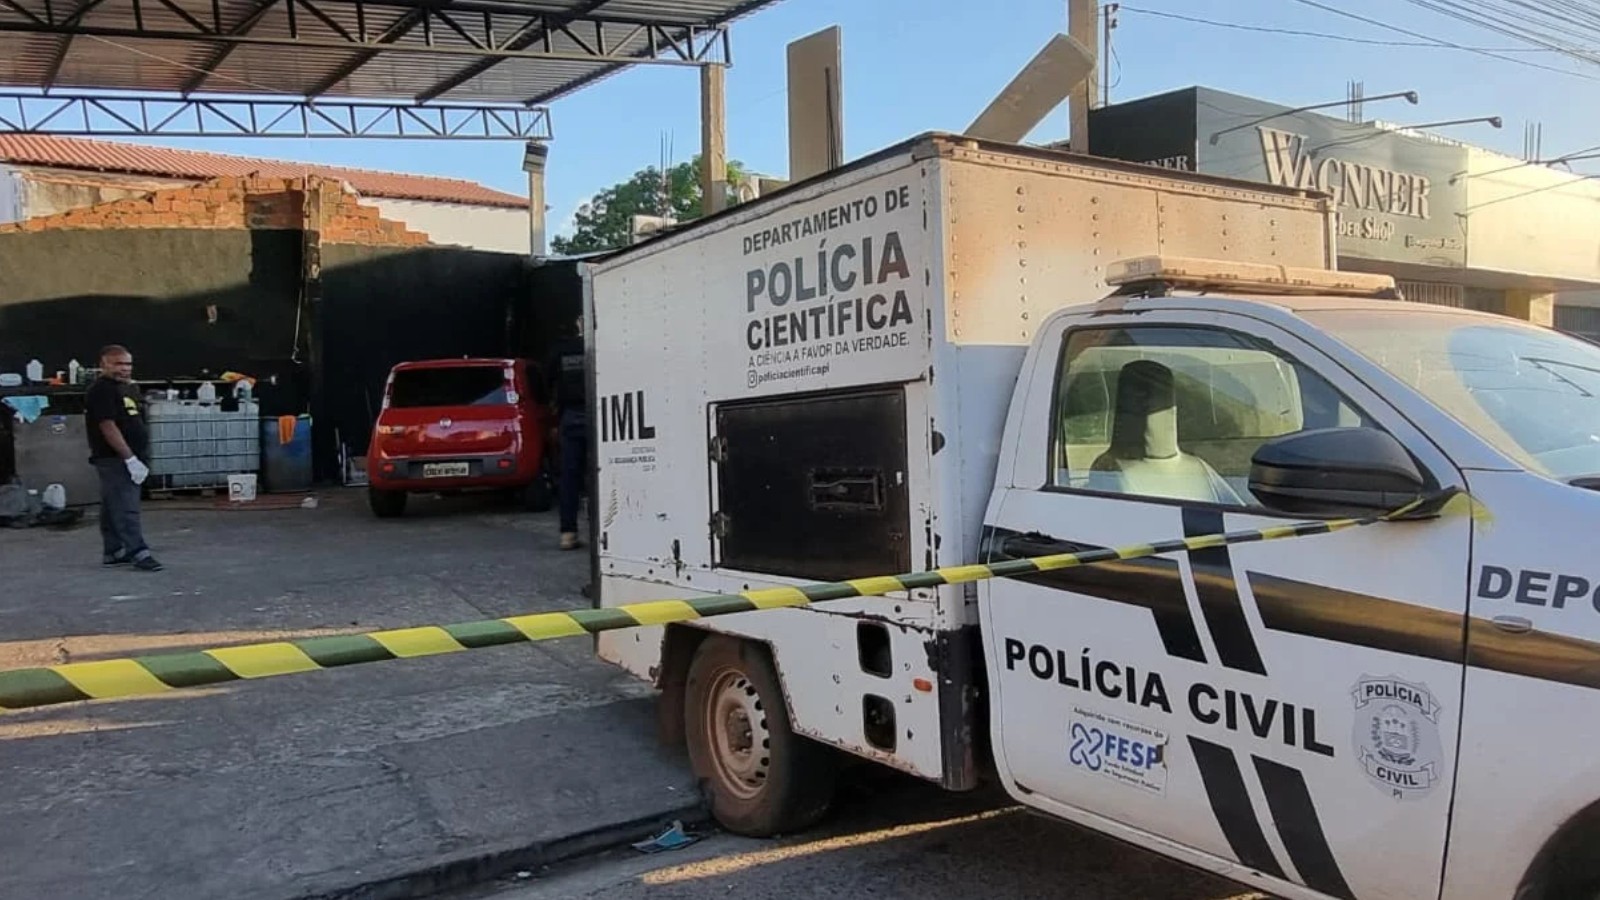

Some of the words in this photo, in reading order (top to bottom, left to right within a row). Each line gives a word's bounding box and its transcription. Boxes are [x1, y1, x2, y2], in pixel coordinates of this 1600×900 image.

[1256, 126, 1431, 219] WAGNNER
[743, 196, 878, 256] DEPARTAMENTO
[884, 185, 910, 213] DE
[746, 231, 911, 313] POLÍCIA
[747, 290, 914, 351] CIENTÍFICA
[801, 342, 833, 361] FAVOR
[835, 340, 850, 356] DA
[851, 331, 910, 352] VERDADE.
[601, 390, 656, 442] IML
[1477, 565, 1600, 614] DEP
[1005, 637, 1172, 713] POLÍCIA
[1188, 682, 1334, 757] CIVIL
[1365, 683, 1423, 707] POLÍCIA
[1104, 733, 1164, 770] FESP
[1376, 766, 1419, 786] CIVIL
